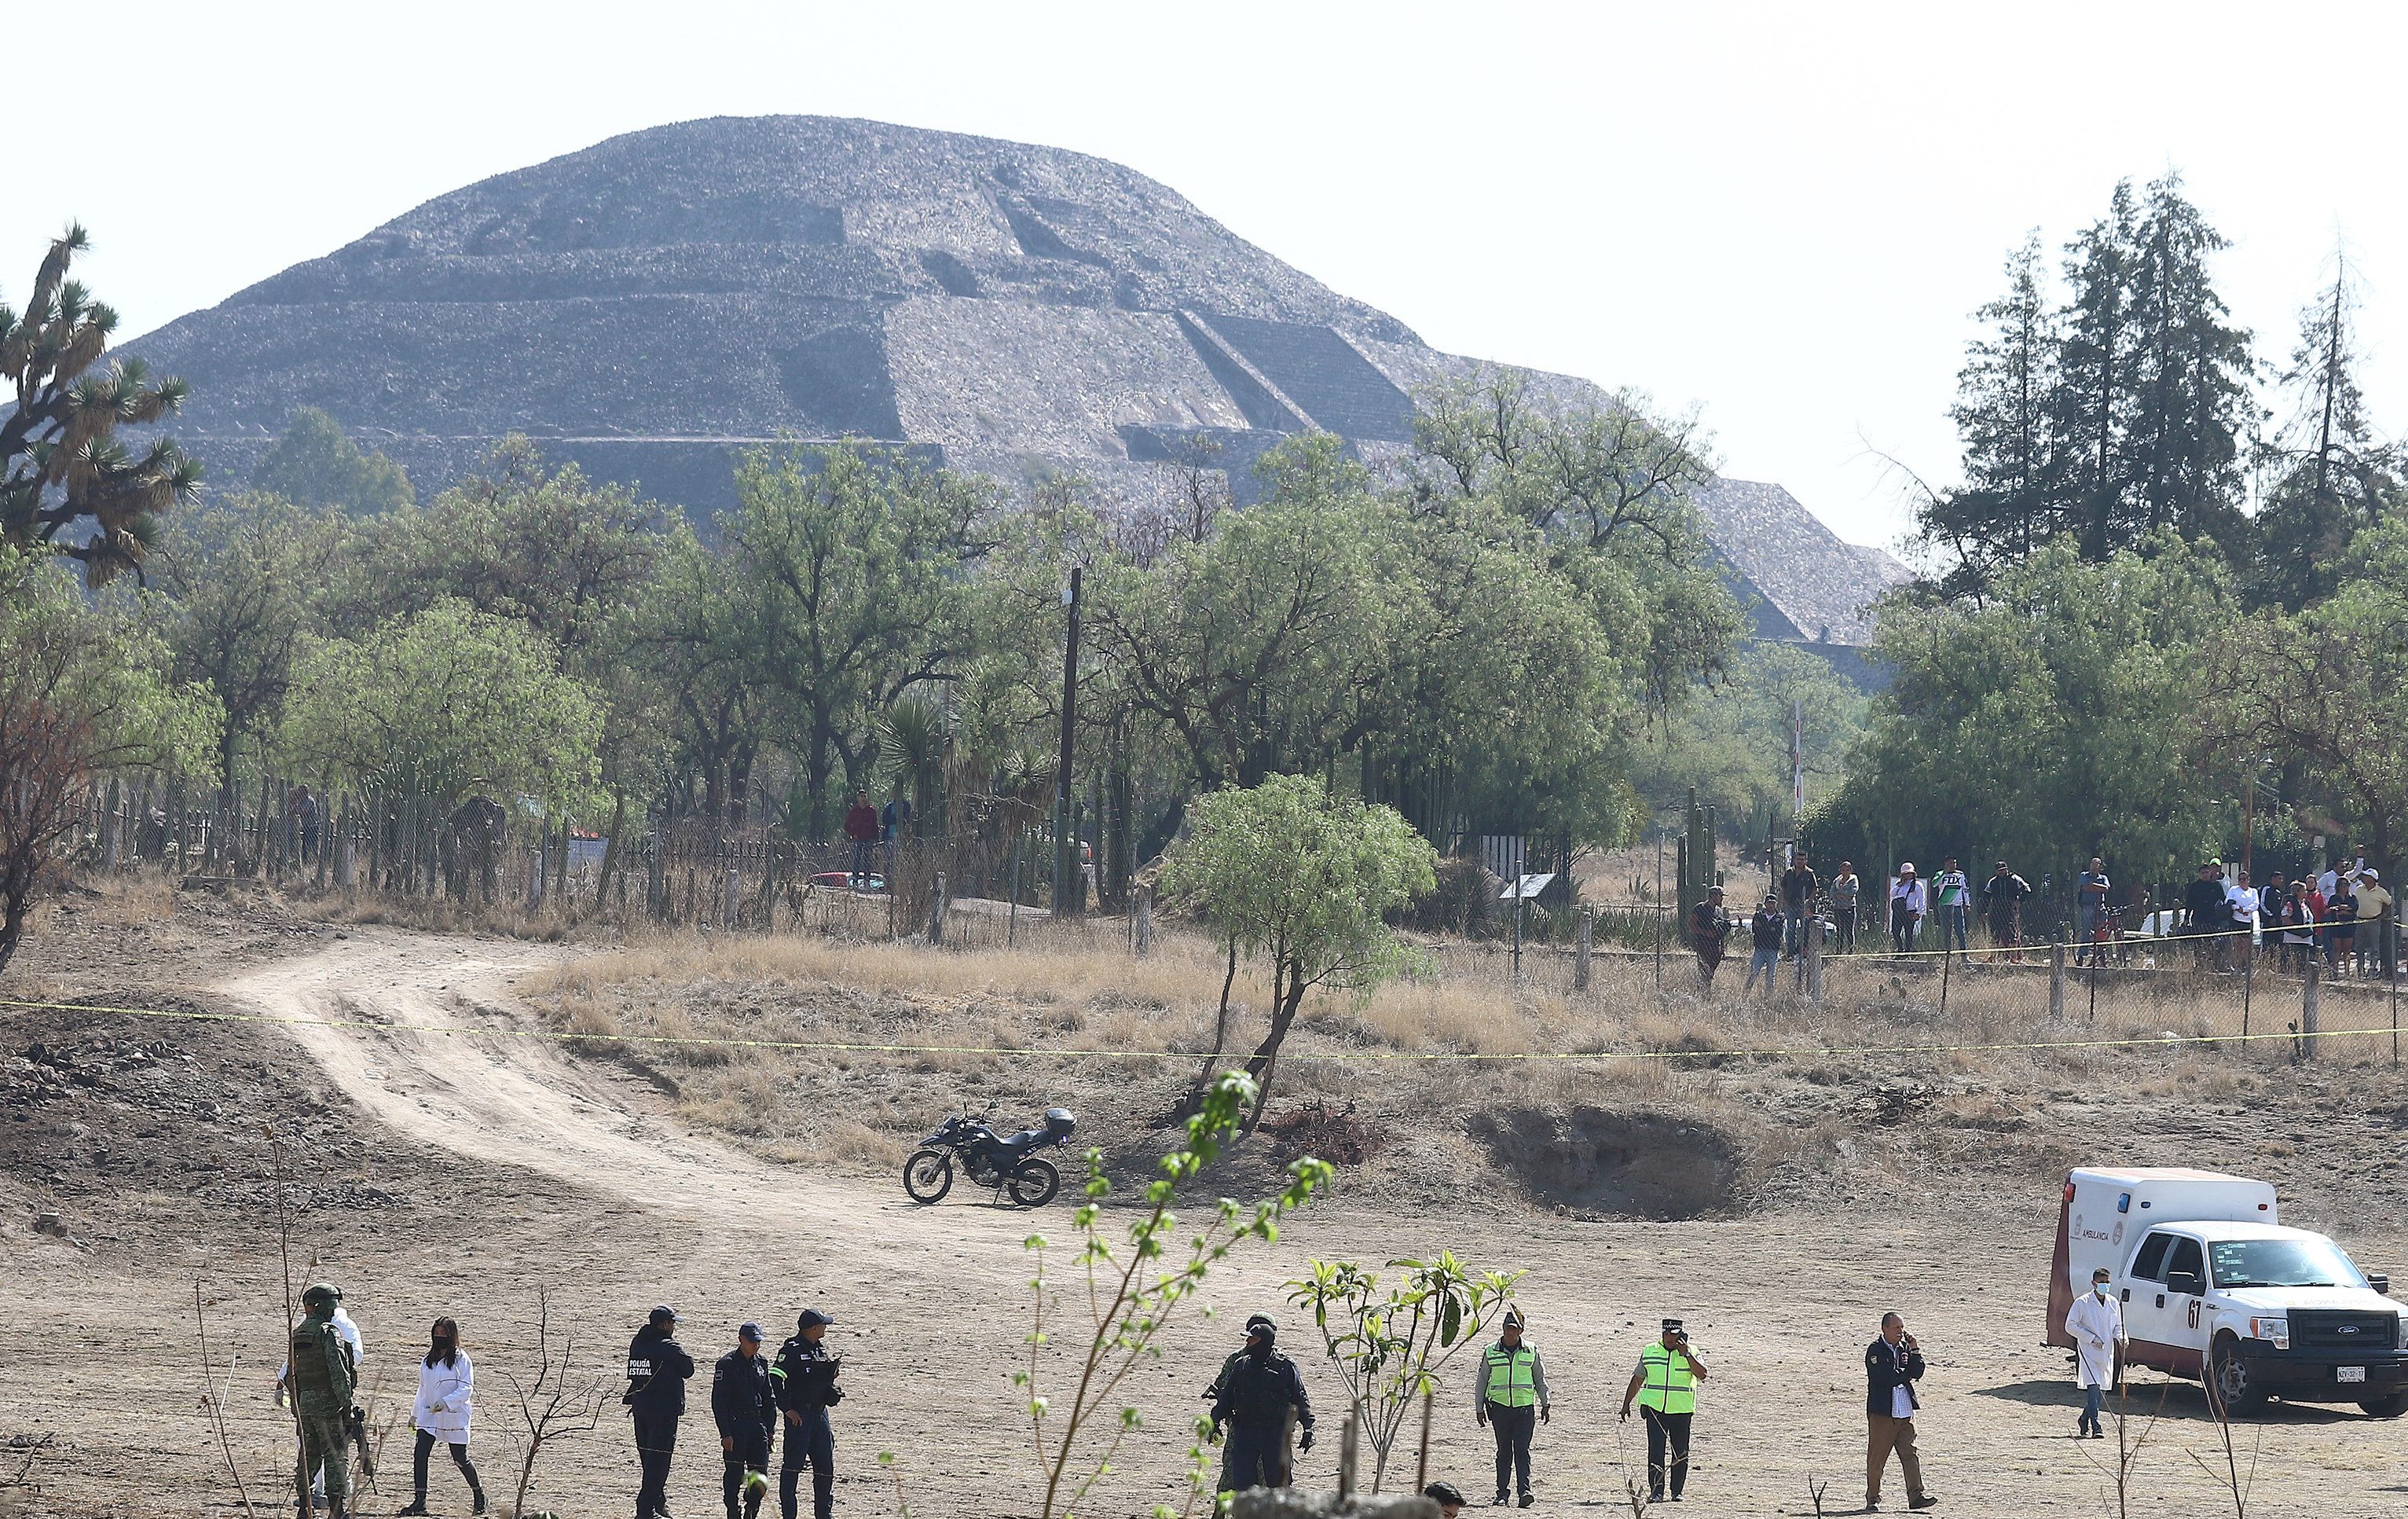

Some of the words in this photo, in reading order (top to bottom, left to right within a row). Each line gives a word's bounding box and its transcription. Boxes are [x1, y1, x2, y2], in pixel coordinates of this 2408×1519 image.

[1942, 876, 1961, 885] FOX
[2083, 1229, 2109, 1241] AMBULANCIA
[2188, 1299, 2201, 1329] 67
[629, 1358, 651, 1367] POLICÍA
[629, 1367, 653, 1376] ESTATAL
